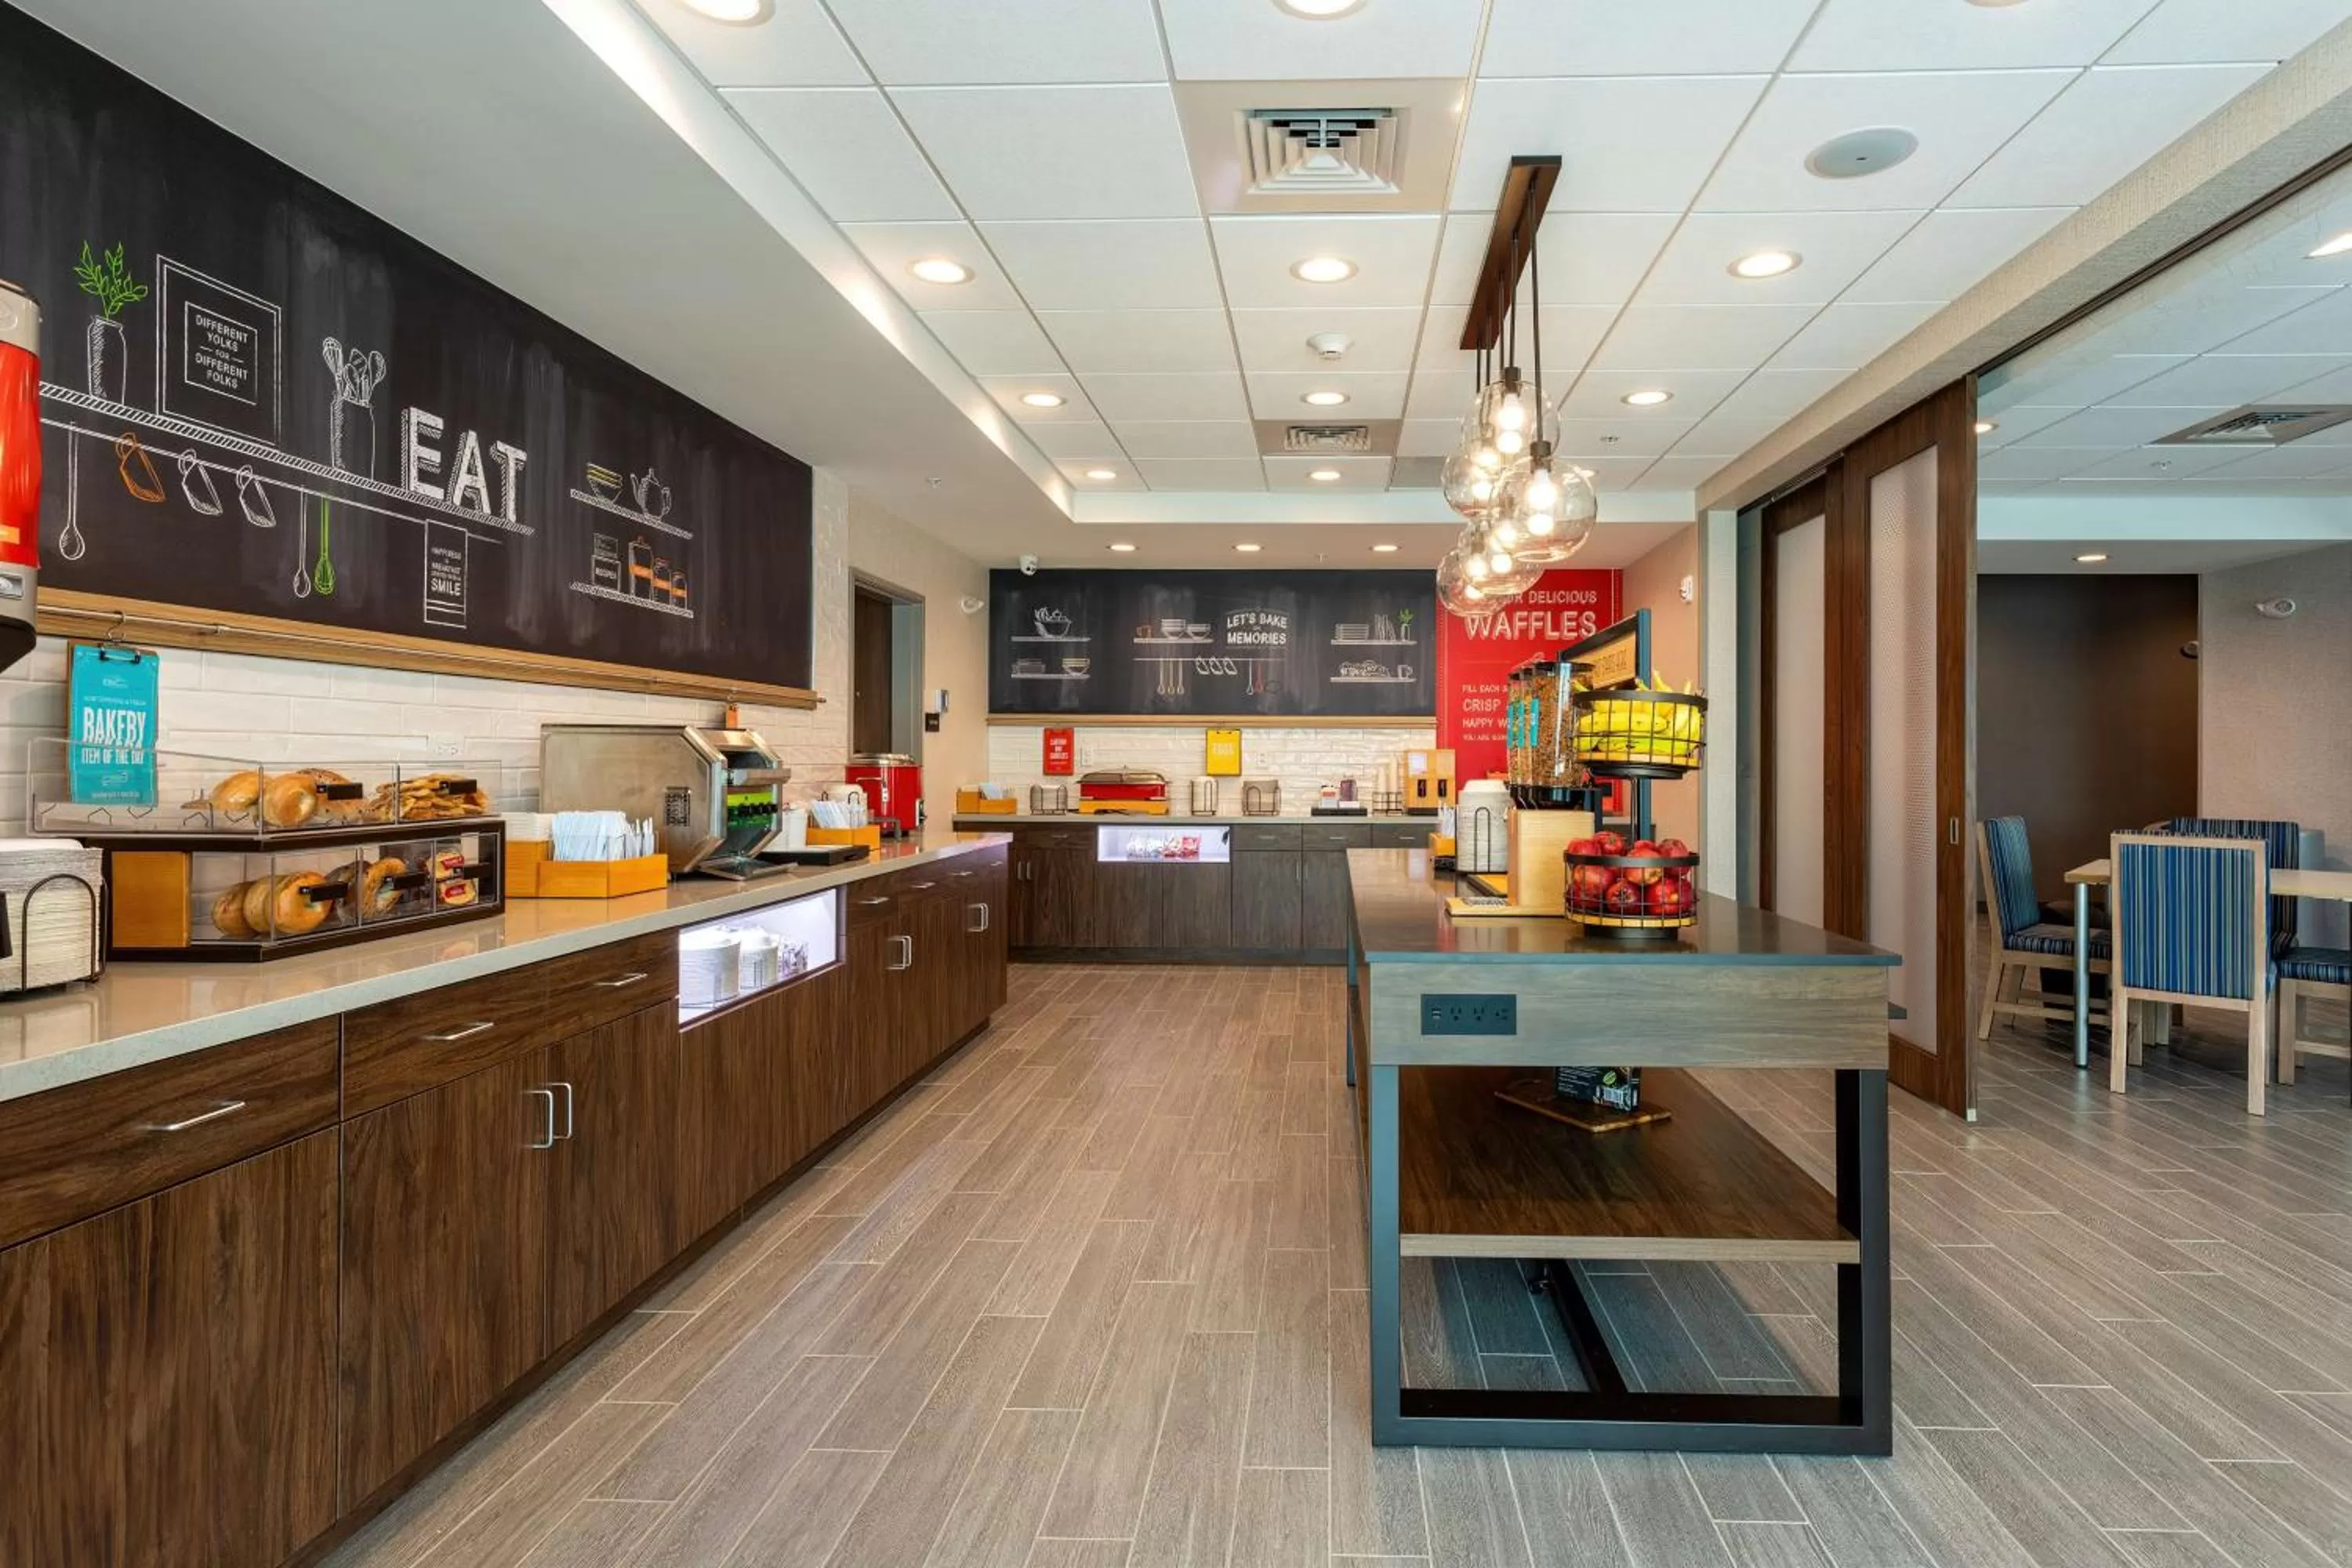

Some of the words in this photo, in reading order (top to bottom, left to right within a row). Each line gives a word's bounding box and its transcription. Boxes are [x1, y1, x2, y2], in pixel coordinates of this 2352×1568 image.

[195, 314, 249, 343] DIFFERENT
[206, 331, 238, 352] YOLKS
[195, 352, 248, 380] DIFFERENT
[206, 369, 238, 389] FOLKS
[401, 405, 528, 524] EAT
[430, 578, 462, 596] SMILE
[1529, 590, 1597, 604] DELICIOUS
[1227, 612, 1256, 629] LET'S
[1259, 612, 1287, 629] BAKE
[1464, 611, 1597, 641] WAFFLES
[1227, 631, 1287, 644] MEMORIES
[1462, 684, 1477, 693] FILL
[1479, 684, 1500, 693] EACH
[1463, 699, 1501, 712] CRISP
[82, 706, 146, 747] BAKERY
[1462, 717, 1494, 728] HAPPY
[81, 747, 101, 765] ITEM
[103, 747, 114, 765] OF
[115, 747, 129, 765] THE
